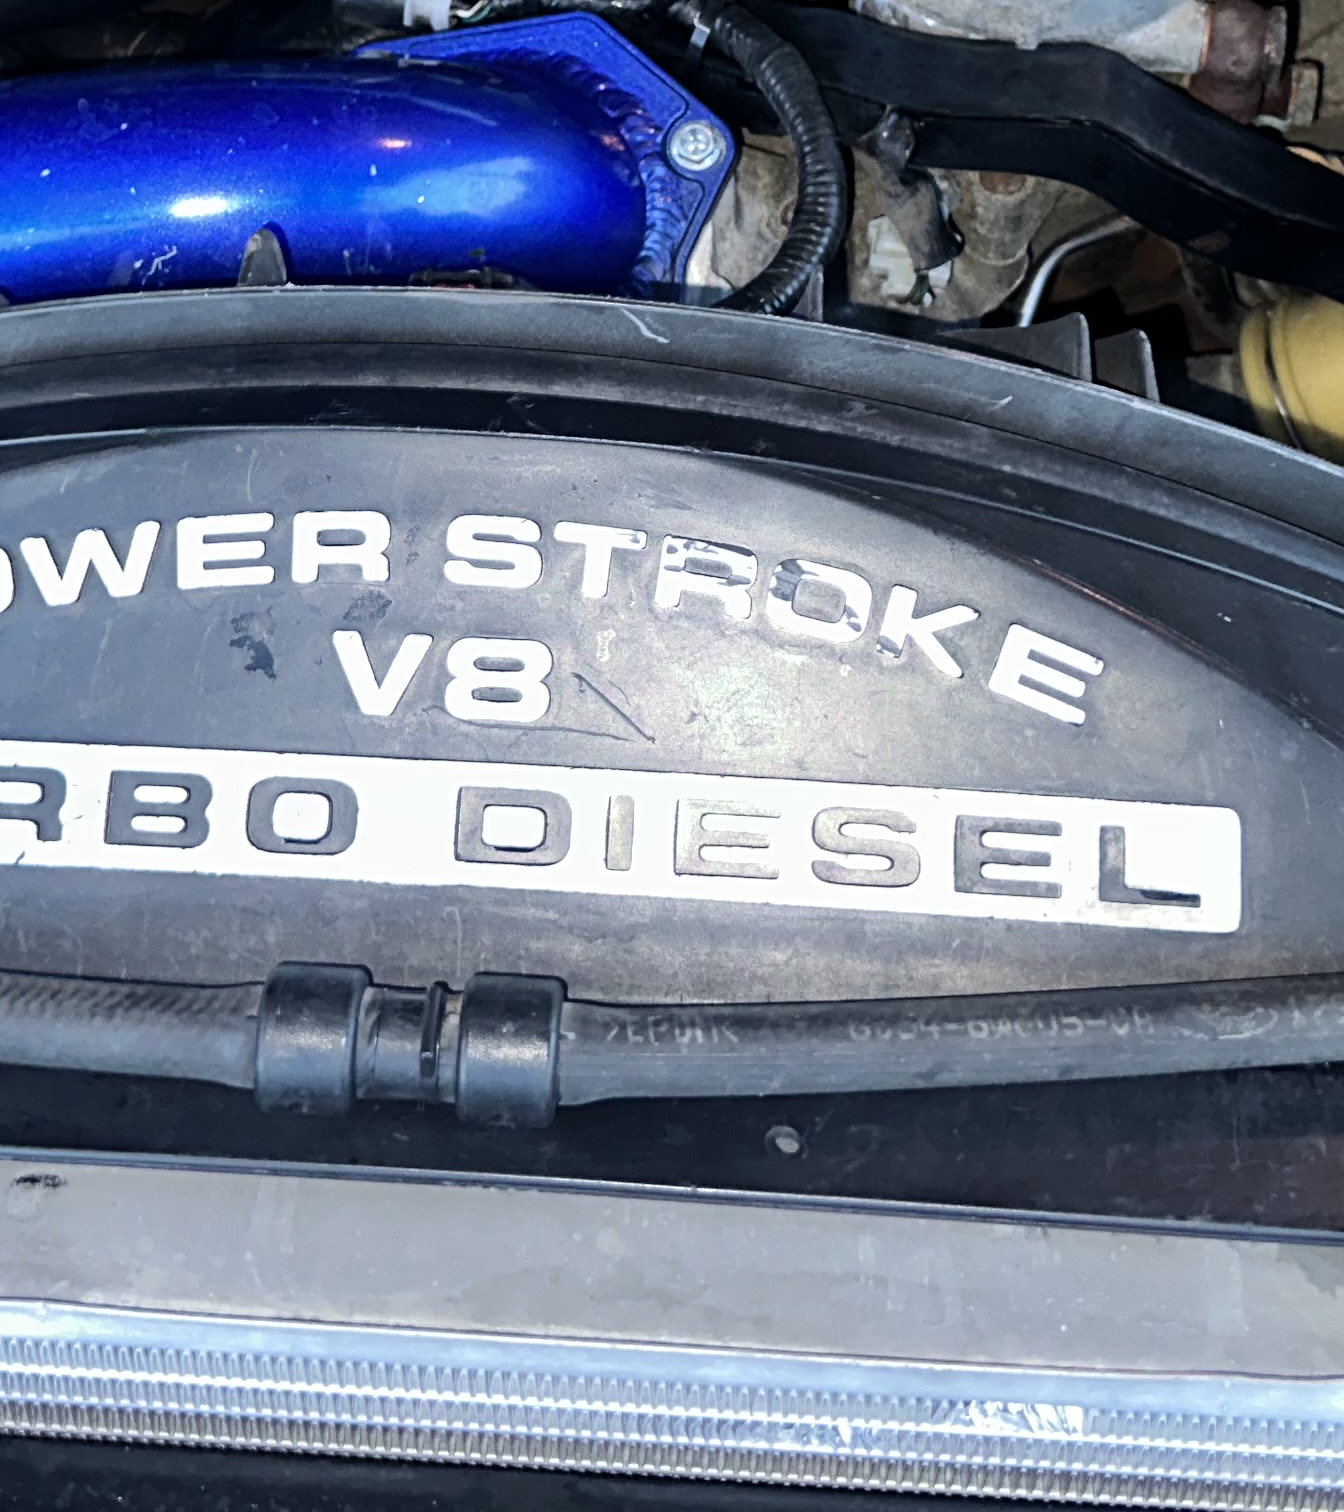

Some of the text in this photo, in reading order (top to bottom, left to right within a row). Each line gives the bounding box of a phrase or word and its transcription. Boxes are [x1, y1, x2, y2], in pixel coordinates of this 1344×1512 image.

[332, 628, 554, 723] V8
[443, 513, 1105, 726] STROKE
[454, 785, 1202, 909] DIESEL
